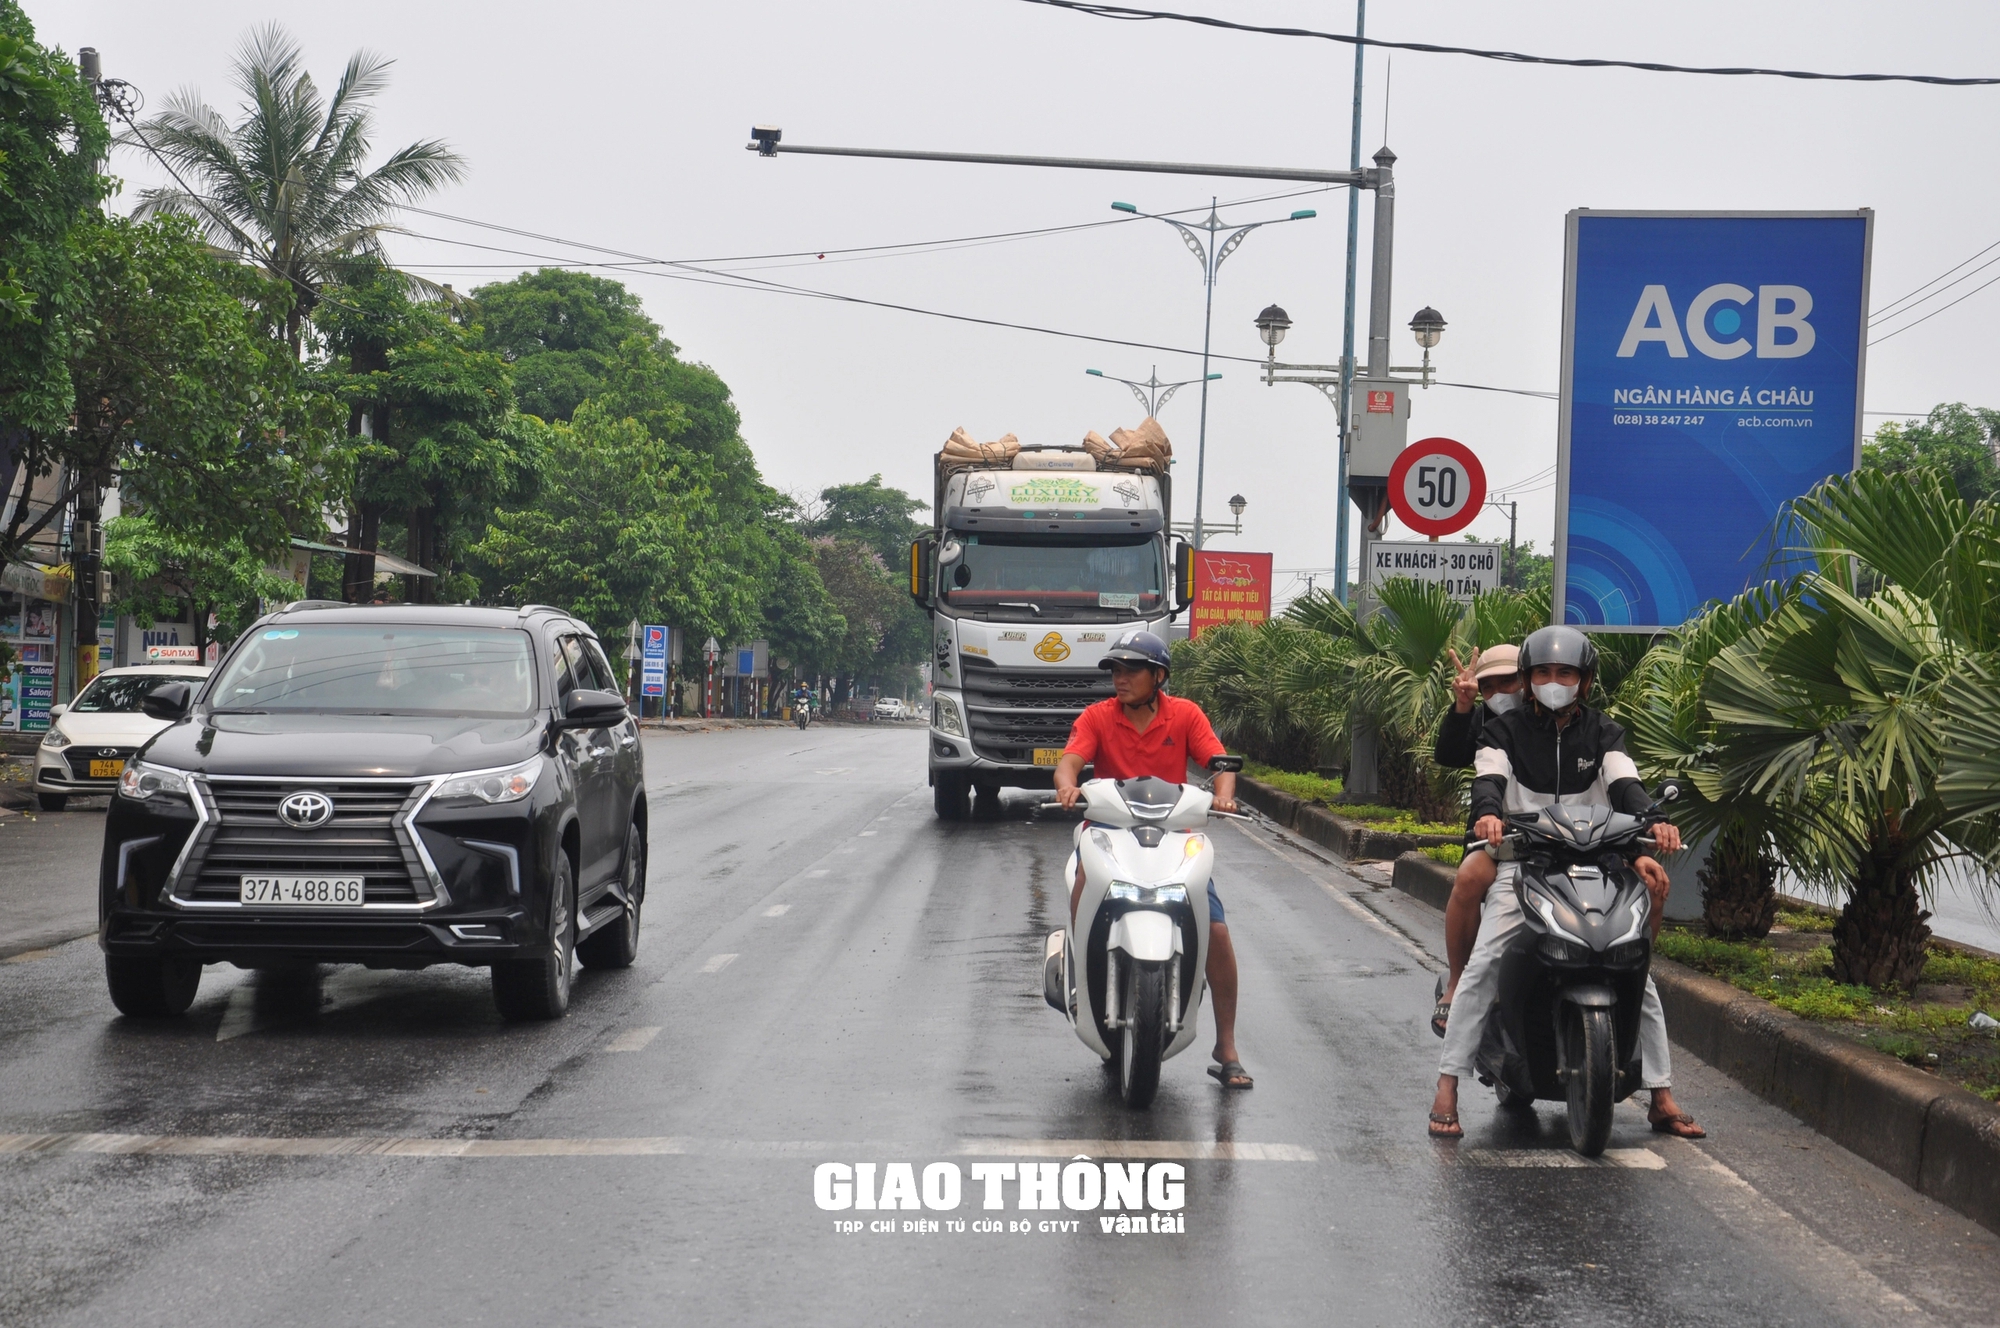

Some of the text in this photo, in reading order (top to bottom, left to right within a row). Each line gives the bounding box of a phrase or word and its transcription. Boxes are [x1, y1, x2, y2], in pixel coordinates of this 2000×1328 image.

[1616, 283, 1816, 360] ACB
[1614, 385, 1814, 406] NGÂN HÀNG Á CHÂU
[1613, 414, 1705, 426] (028) 38 247 247
[1737, 416, 1813, 428] acb.com.vn
[1418, 466, 1457, 508] 50
[1376, 552, 1391, 568] XE
[1395, 550, 1437, 569] KHÁCH
[1451, 554, 1465, 570] 30
[1469, 548, 1494, 570] CHỖ
[1457, 575, 1481, 595] TẤN
[1202, 587, 1259, 605] TẤT CẢ VÌ MỤC TIÊU
[1196, 606, 1209, 619] DÂN
[143, 628, 179, 652] NHÀ
[1043, 749, 1058, 757] 37H
[100, 761, 114, 769] 74A
[245, 879, 359, 902] 37A-488.66
